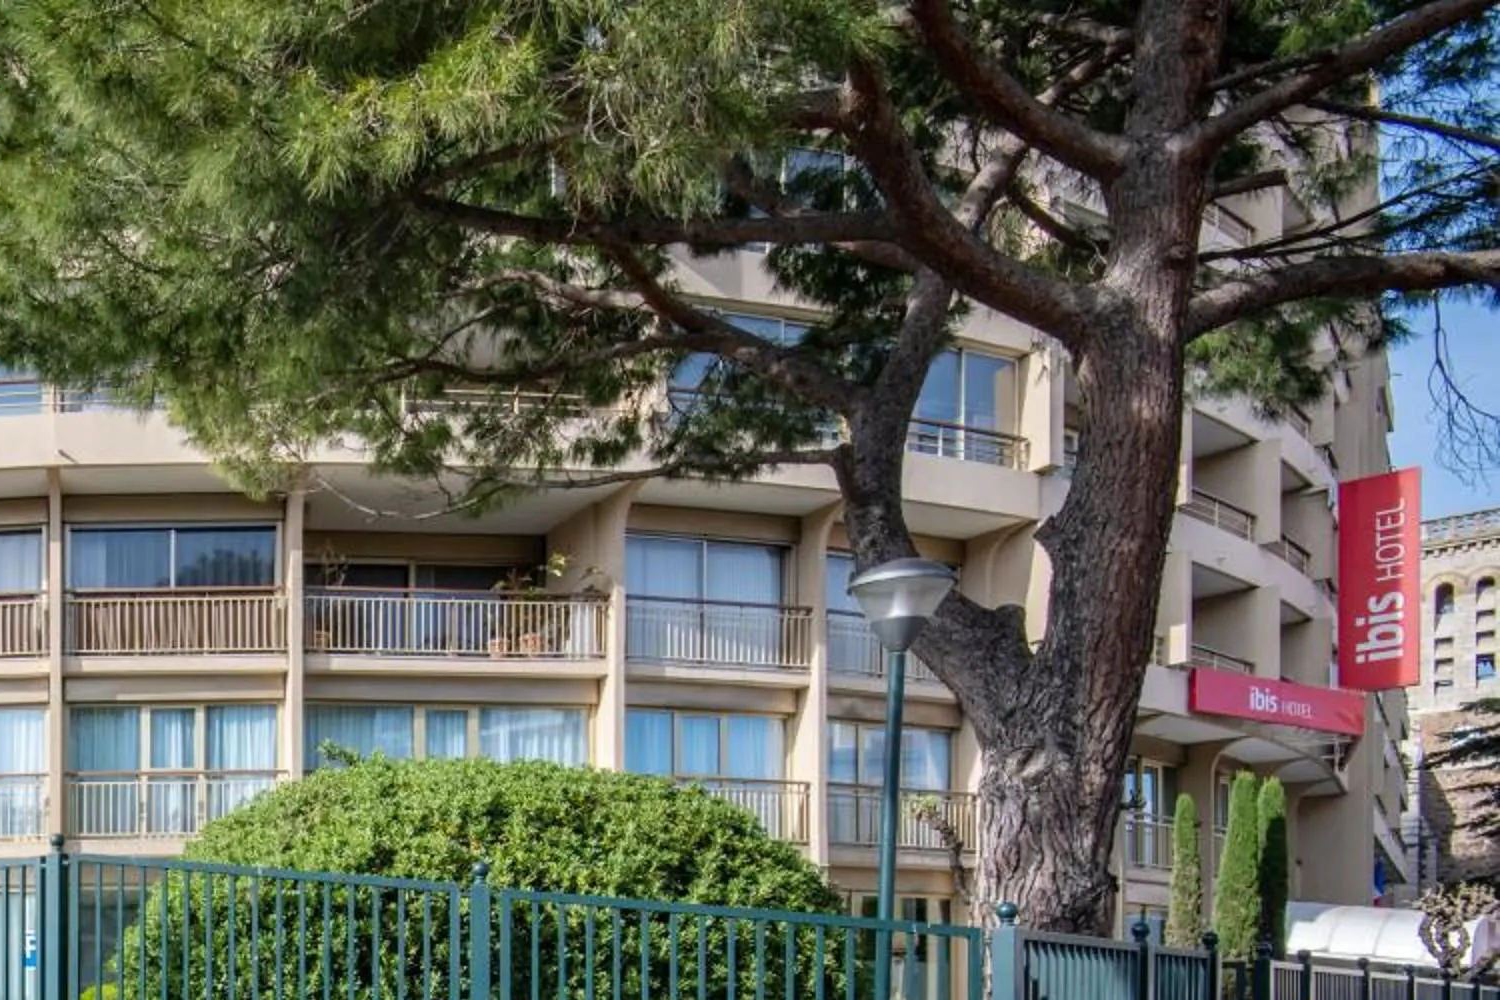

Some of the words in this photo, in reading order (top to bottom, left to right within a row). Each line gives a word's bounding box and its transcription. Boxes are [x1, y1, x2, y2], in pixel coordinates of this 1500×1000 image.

[1375, 497, 1406, 582] HOTEL
[1355, 591, 1405, 665] ibis
[1249, 686, 1278, 713] ibis
[1280, 700, 1314, 719] HOTEL
